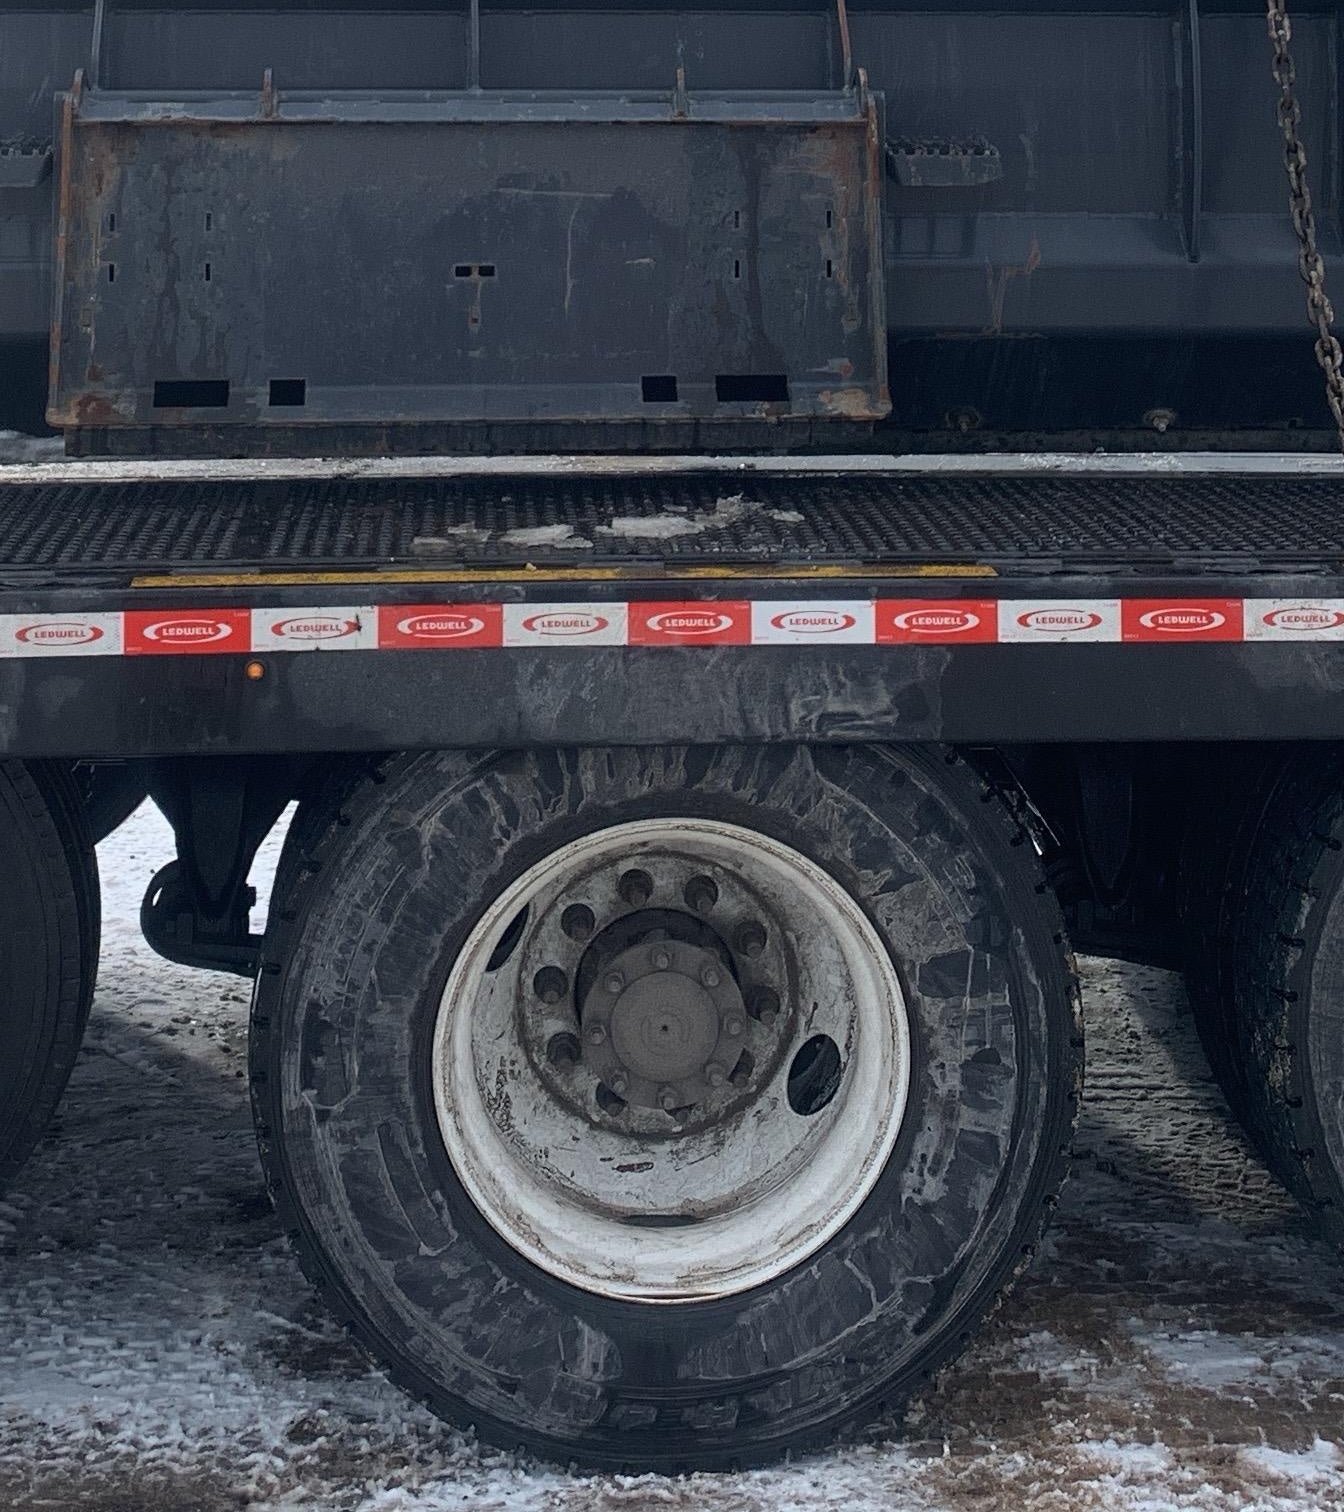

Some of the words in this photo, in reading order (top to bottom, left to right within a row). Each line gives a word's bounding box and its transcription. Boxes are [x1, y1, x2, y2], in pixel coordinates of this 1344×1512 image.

[541, 618, 592, 629] LEDWELL
[665, 617, 717, 628] LEDWELL
[789, 616, 840, 627] LEDWELL
[912, 616, 963, 626] LEDWELL
[1036, 616, 1086, 626] LEDWELL
[1158, 615, 1209, 625] LEDWELL
[1281, 615, 1331, 623] LEDWELL
[290, 623, 342, 633] LEDWELL
[416, 620, 467, 631] LEDWELL
[34, 630, 88, 640] LEDWELL
[162, 626, 215, 637] LEDWELL
